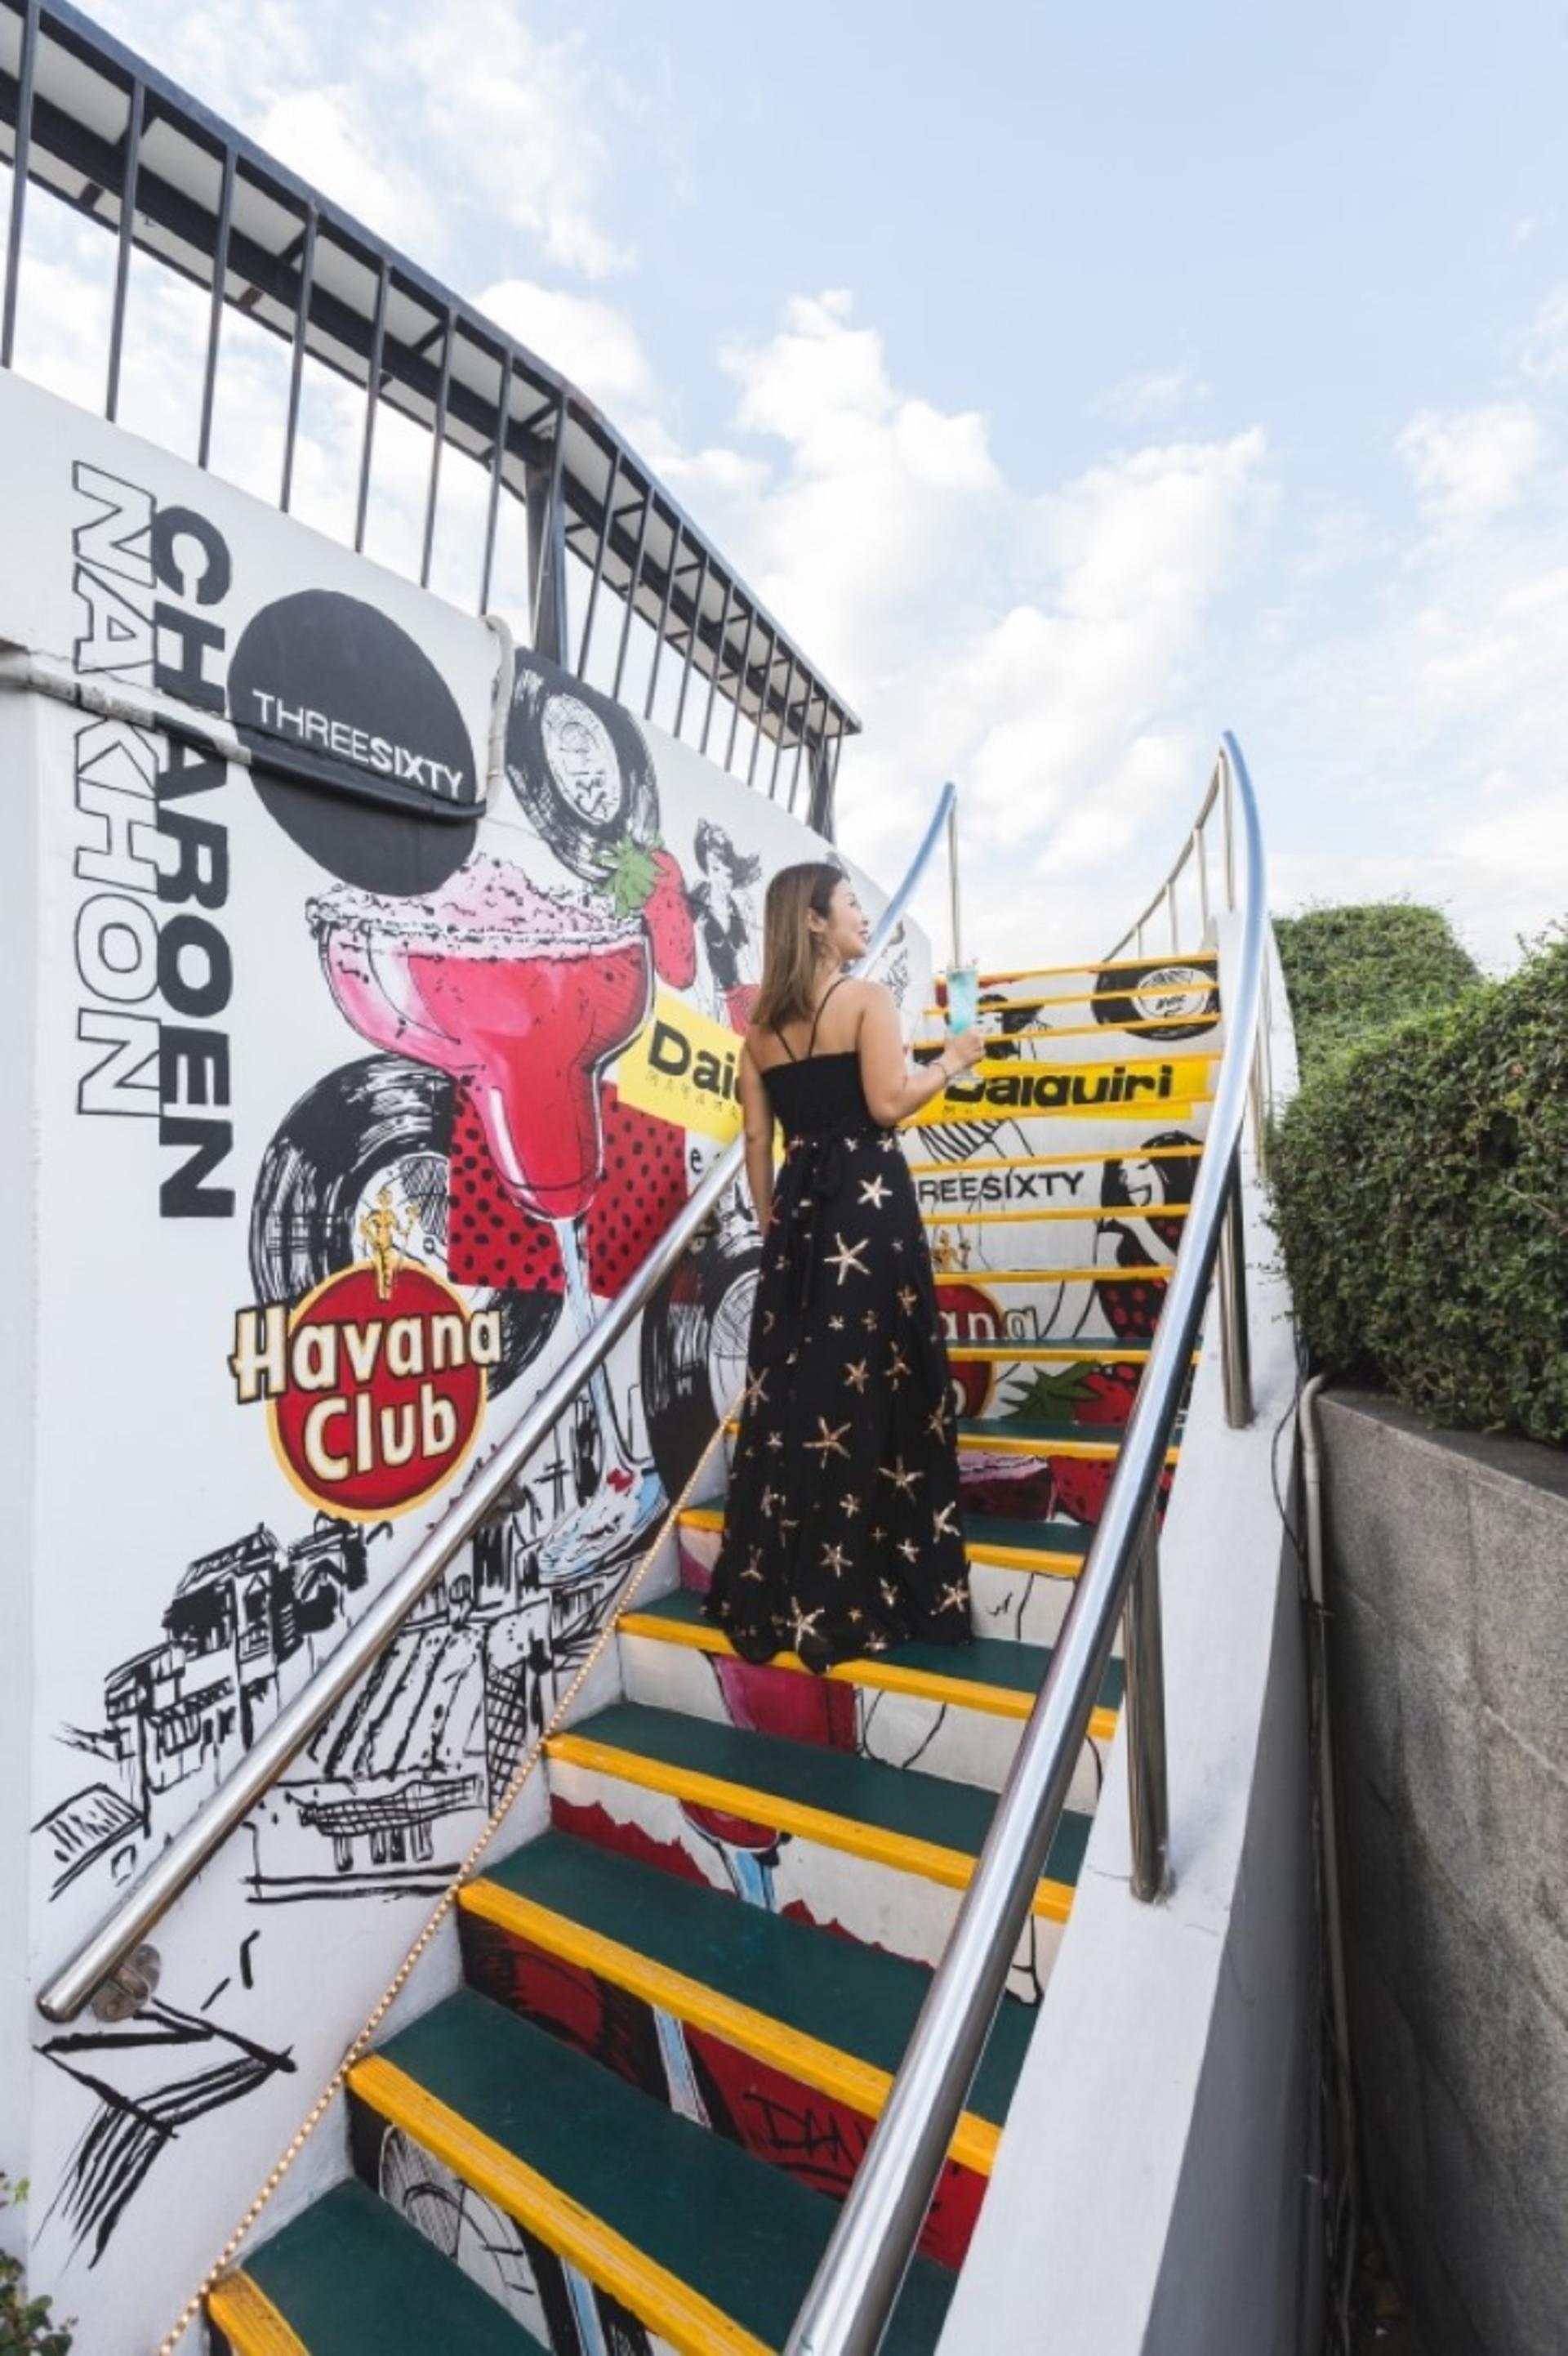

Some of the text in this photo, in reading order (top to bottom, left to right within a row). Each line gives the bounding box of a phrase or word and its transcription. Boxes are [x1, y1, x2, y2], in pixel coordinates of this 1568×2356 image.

[72, 459, 164, 1118] NAKHON
[252, 688, 463, 800] THREESIXTY
[152, 504, 236, 1219] CHAROEN
[648, 1020, 742, 1104] Dai
[918, 1170, 1085, 1204] REESIXTY
[229, 1302, 502, 1403] Havana
[304, 1382, 457, 1483] Club
